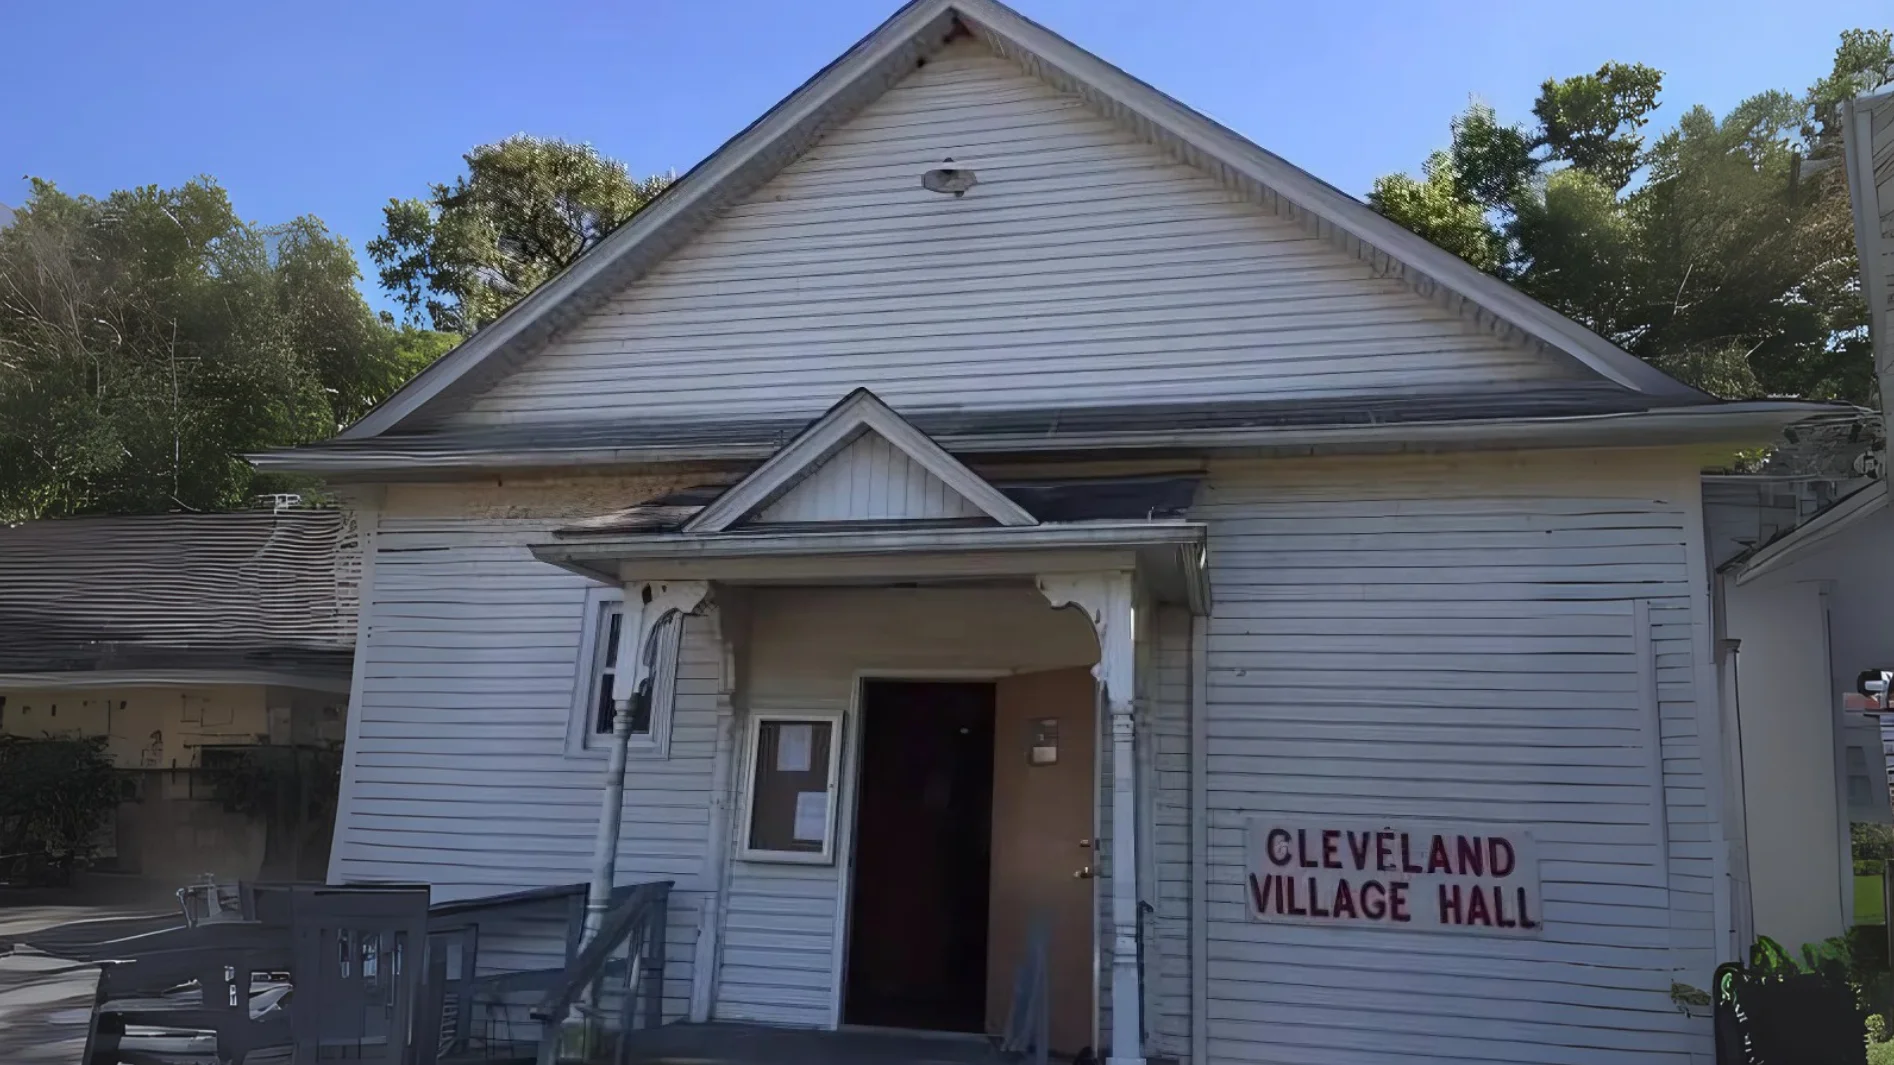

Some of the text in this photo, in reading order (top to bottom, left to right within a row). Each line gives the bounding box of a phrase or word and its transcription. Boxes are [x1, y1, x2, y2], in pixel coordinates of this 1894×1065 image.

[1266, 828, 1515, 878] CLEVELAND
[1250, 873, 1540, 928] VILLAGE HALL
